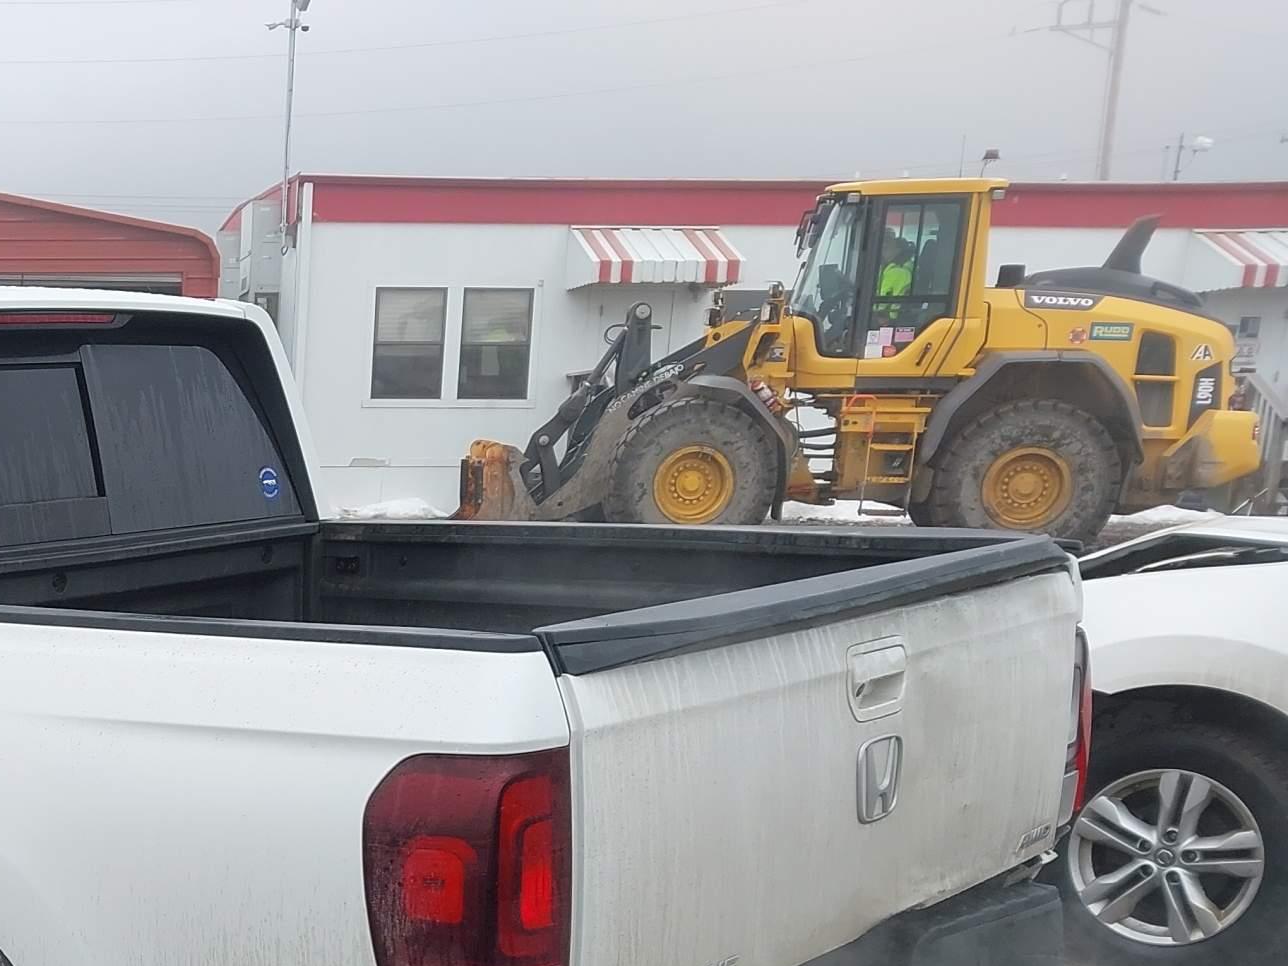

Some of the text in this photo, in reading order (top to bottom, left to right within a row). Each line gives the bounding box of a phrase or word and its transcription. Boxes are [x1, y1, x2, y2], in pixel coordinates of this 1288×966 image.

[1031, 295, 1094, 306] VOLVO
[1092, 325, 1130, 338] RUDD
[1196, 377, 1216, 405] L90H
